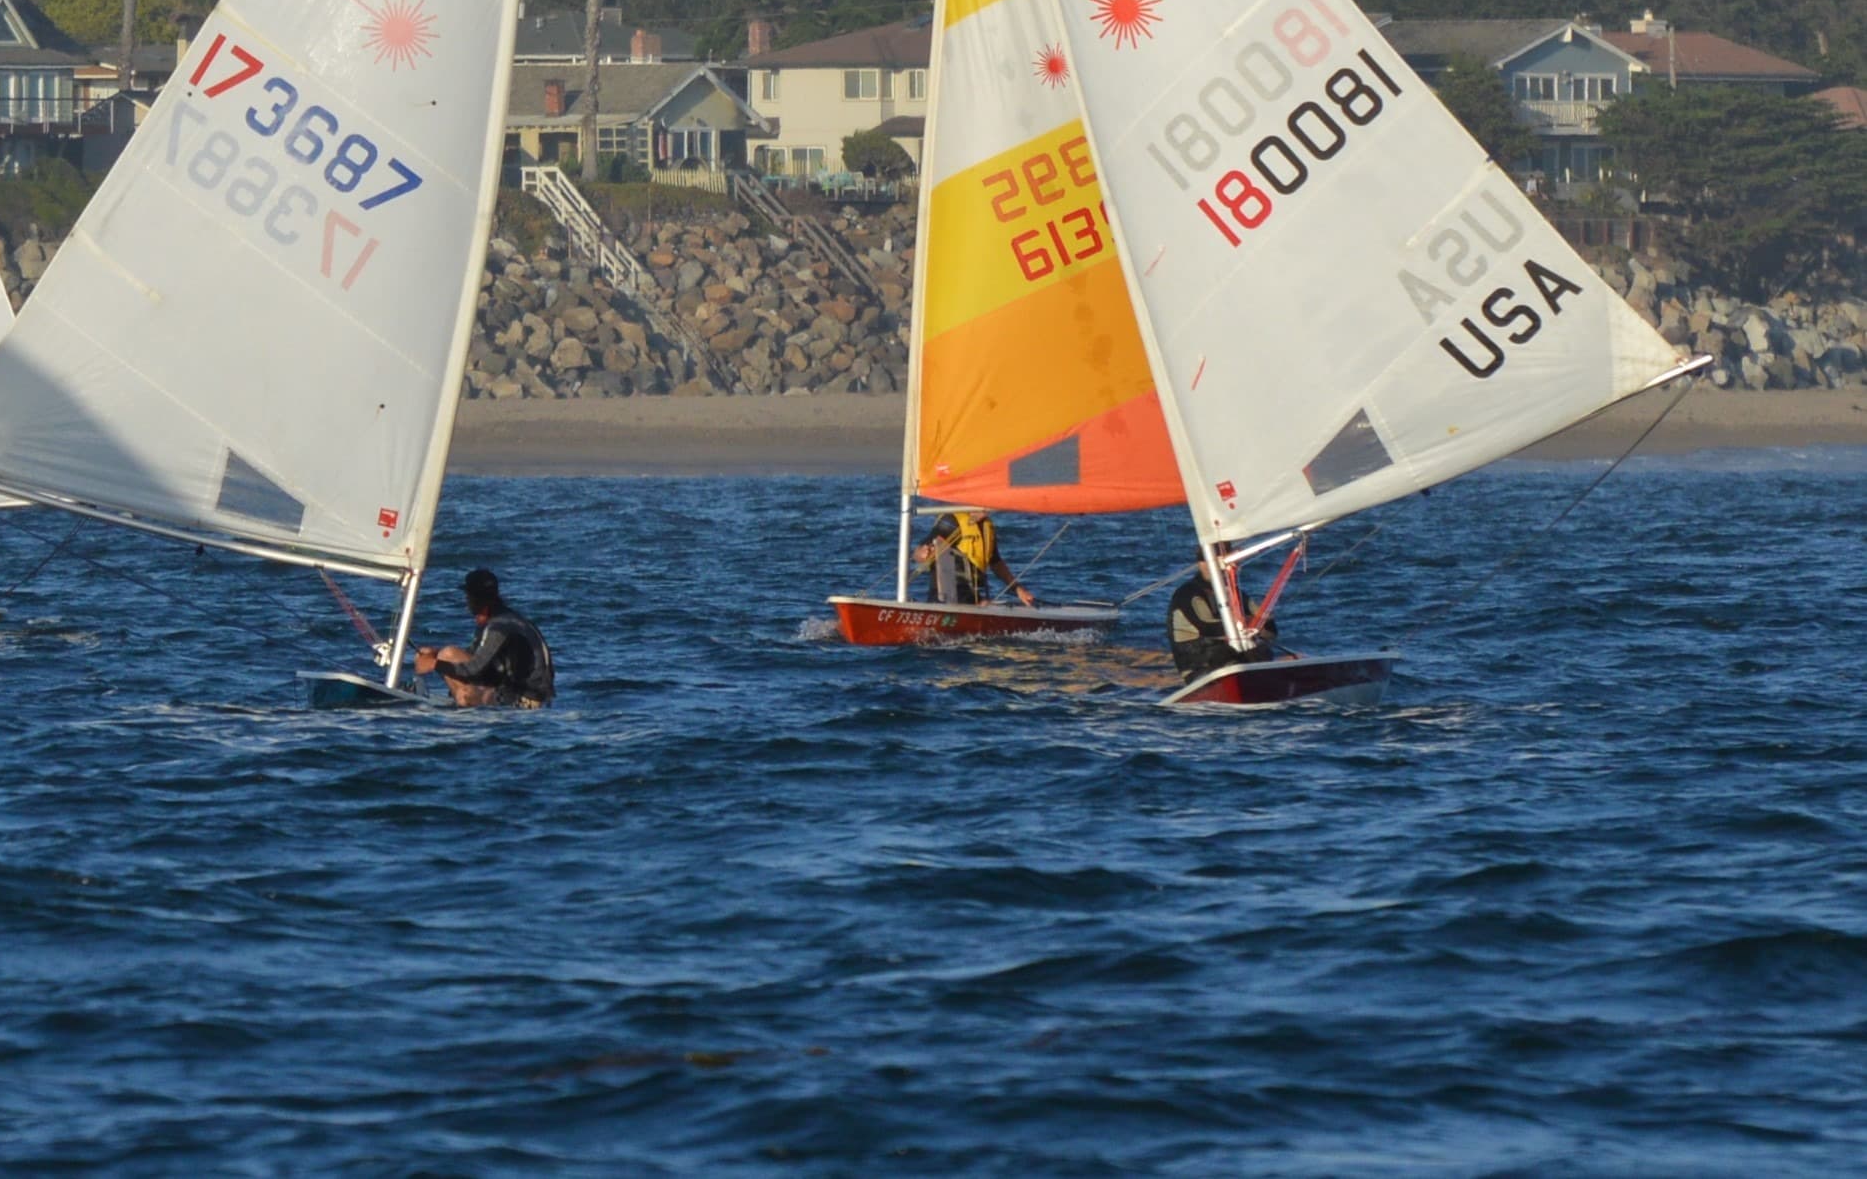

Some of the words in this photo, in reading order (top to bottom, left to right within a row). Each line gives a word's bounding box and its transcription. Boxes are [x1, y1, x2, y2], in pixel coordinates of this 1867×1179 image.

[189, 33, 423, 210] 173687
[1197, 48, 1403, 248] 180081
[1011, 200, 1115, 281] 613
[1439, 259, 1583, 379] USA
[877, 609, 894, 623] CF
